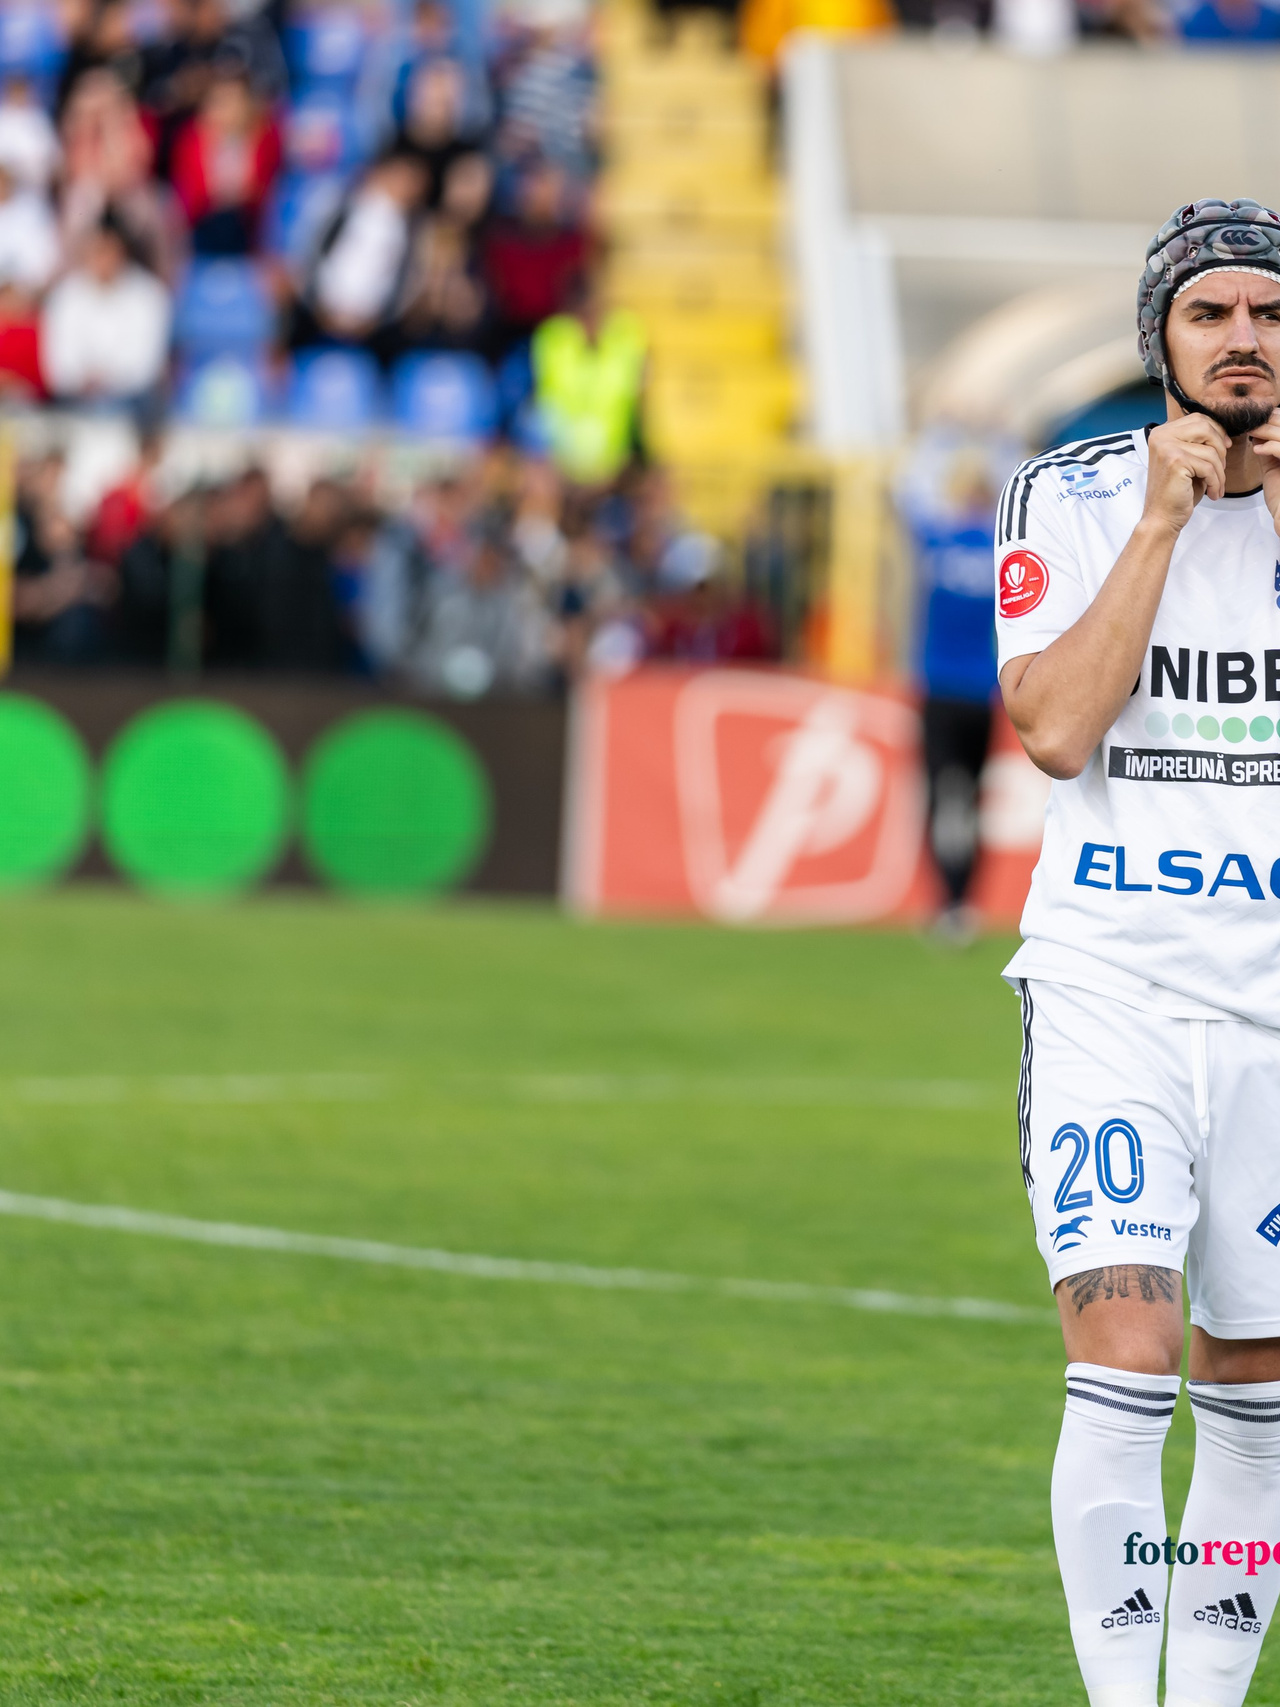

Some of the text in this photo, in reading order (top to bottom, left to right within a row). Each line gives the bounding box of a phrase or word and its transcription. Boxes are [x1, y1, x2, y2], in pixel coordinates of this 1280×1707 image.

[1124, 749, 1228, 782] ÎMPREUNĂ
[1050, 1118, 1145, 1213] 20
[1111, 1218, 1173, 1241] Vestra
[1101, 1609, 1160, 1629] adidas
[1193, 1608, 1262, 1634] adidas
